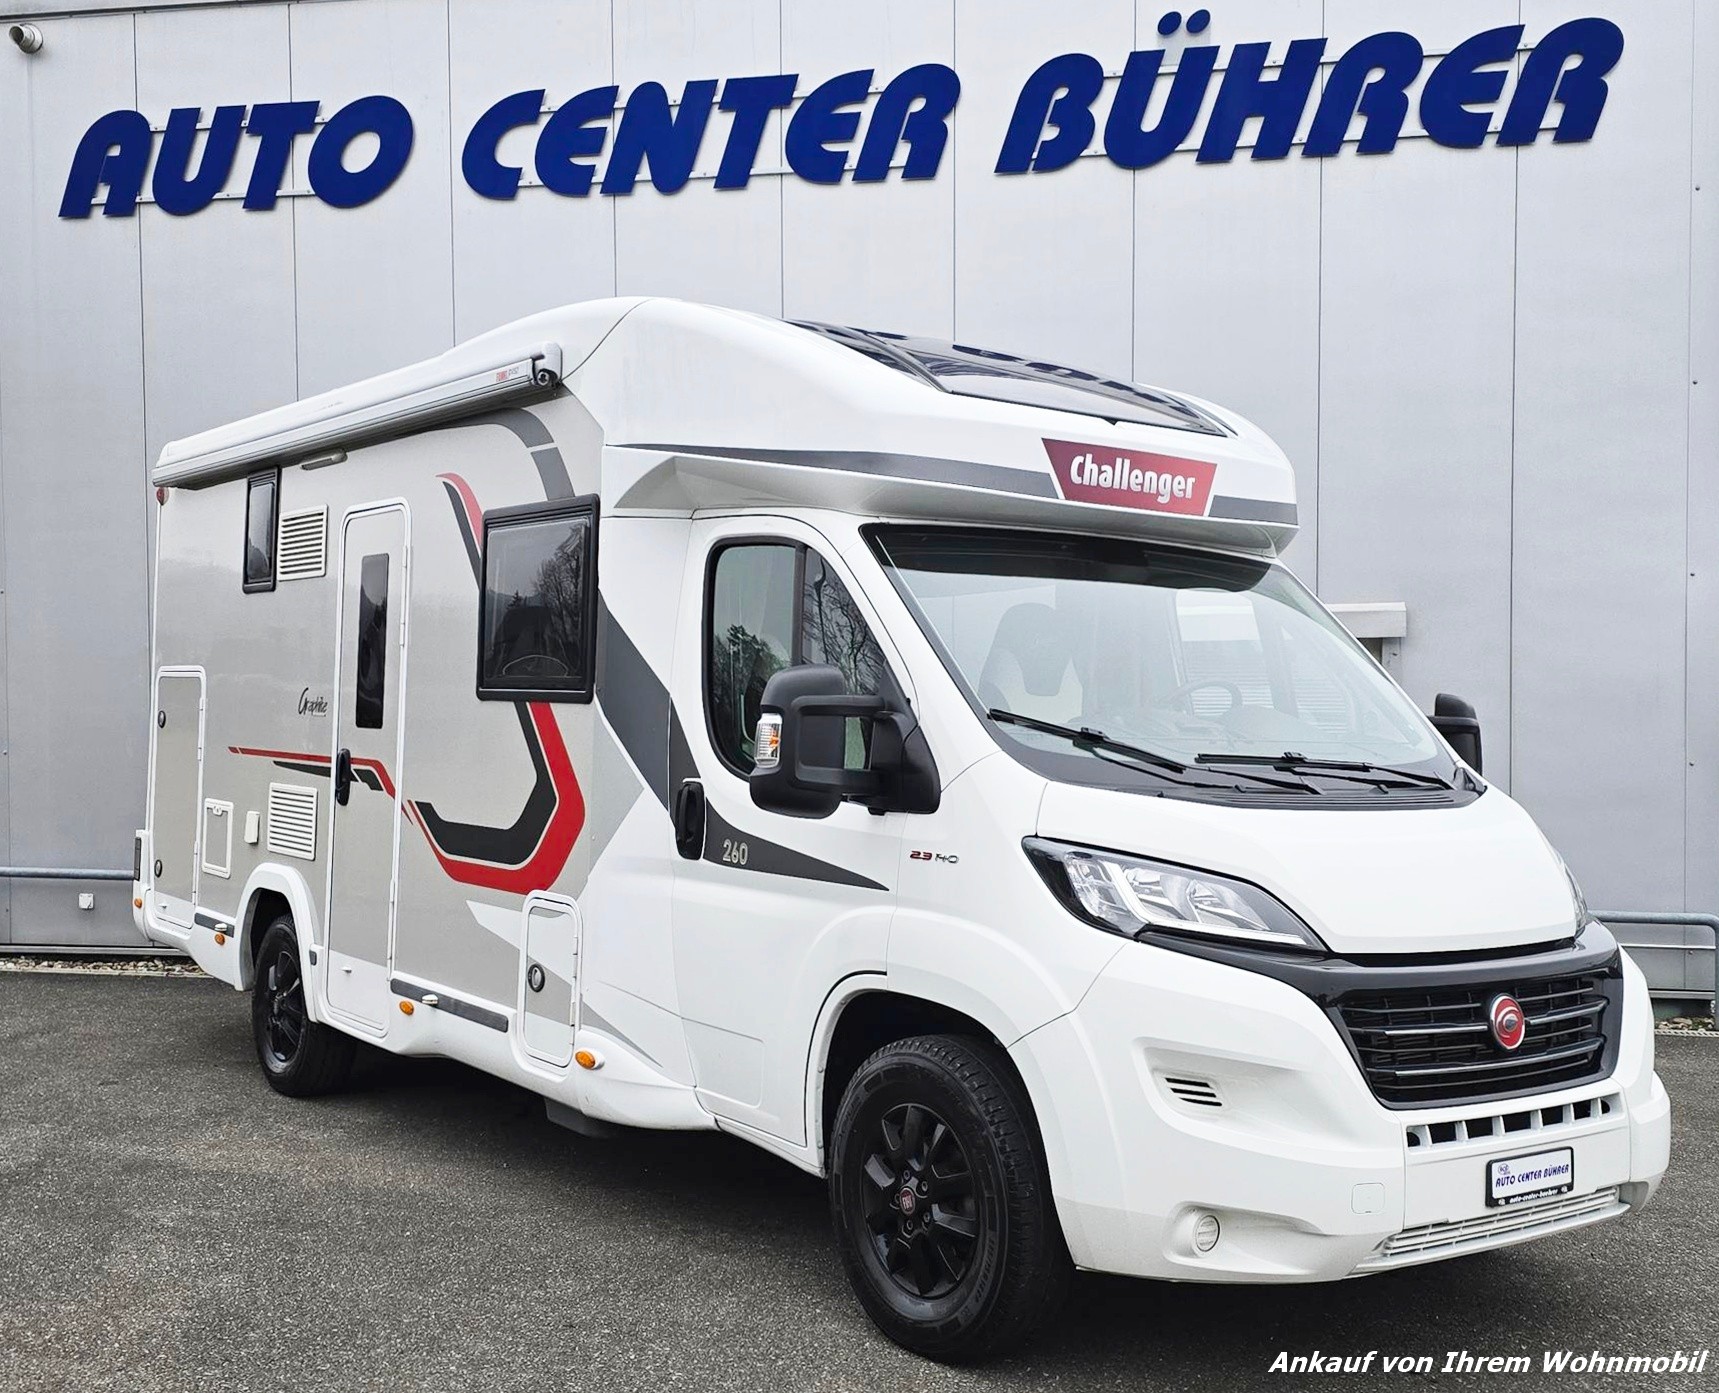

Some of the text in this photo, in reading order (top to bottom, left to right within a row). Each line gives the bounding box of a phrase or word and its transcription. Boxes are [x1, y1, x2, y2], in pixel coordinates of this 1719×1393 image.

[60, 10, 1623, 216] AUTO CENTER BÜHRER
[1070, 453, 1196, 504] Challenger
[722, 838, 748, 865] 260
[1495, 1175, 1516, 1187] AUTO
[1517, 1169, 1542, 1183] CENTER
[1543, 1164, 1569, 1178] BÜHRER
